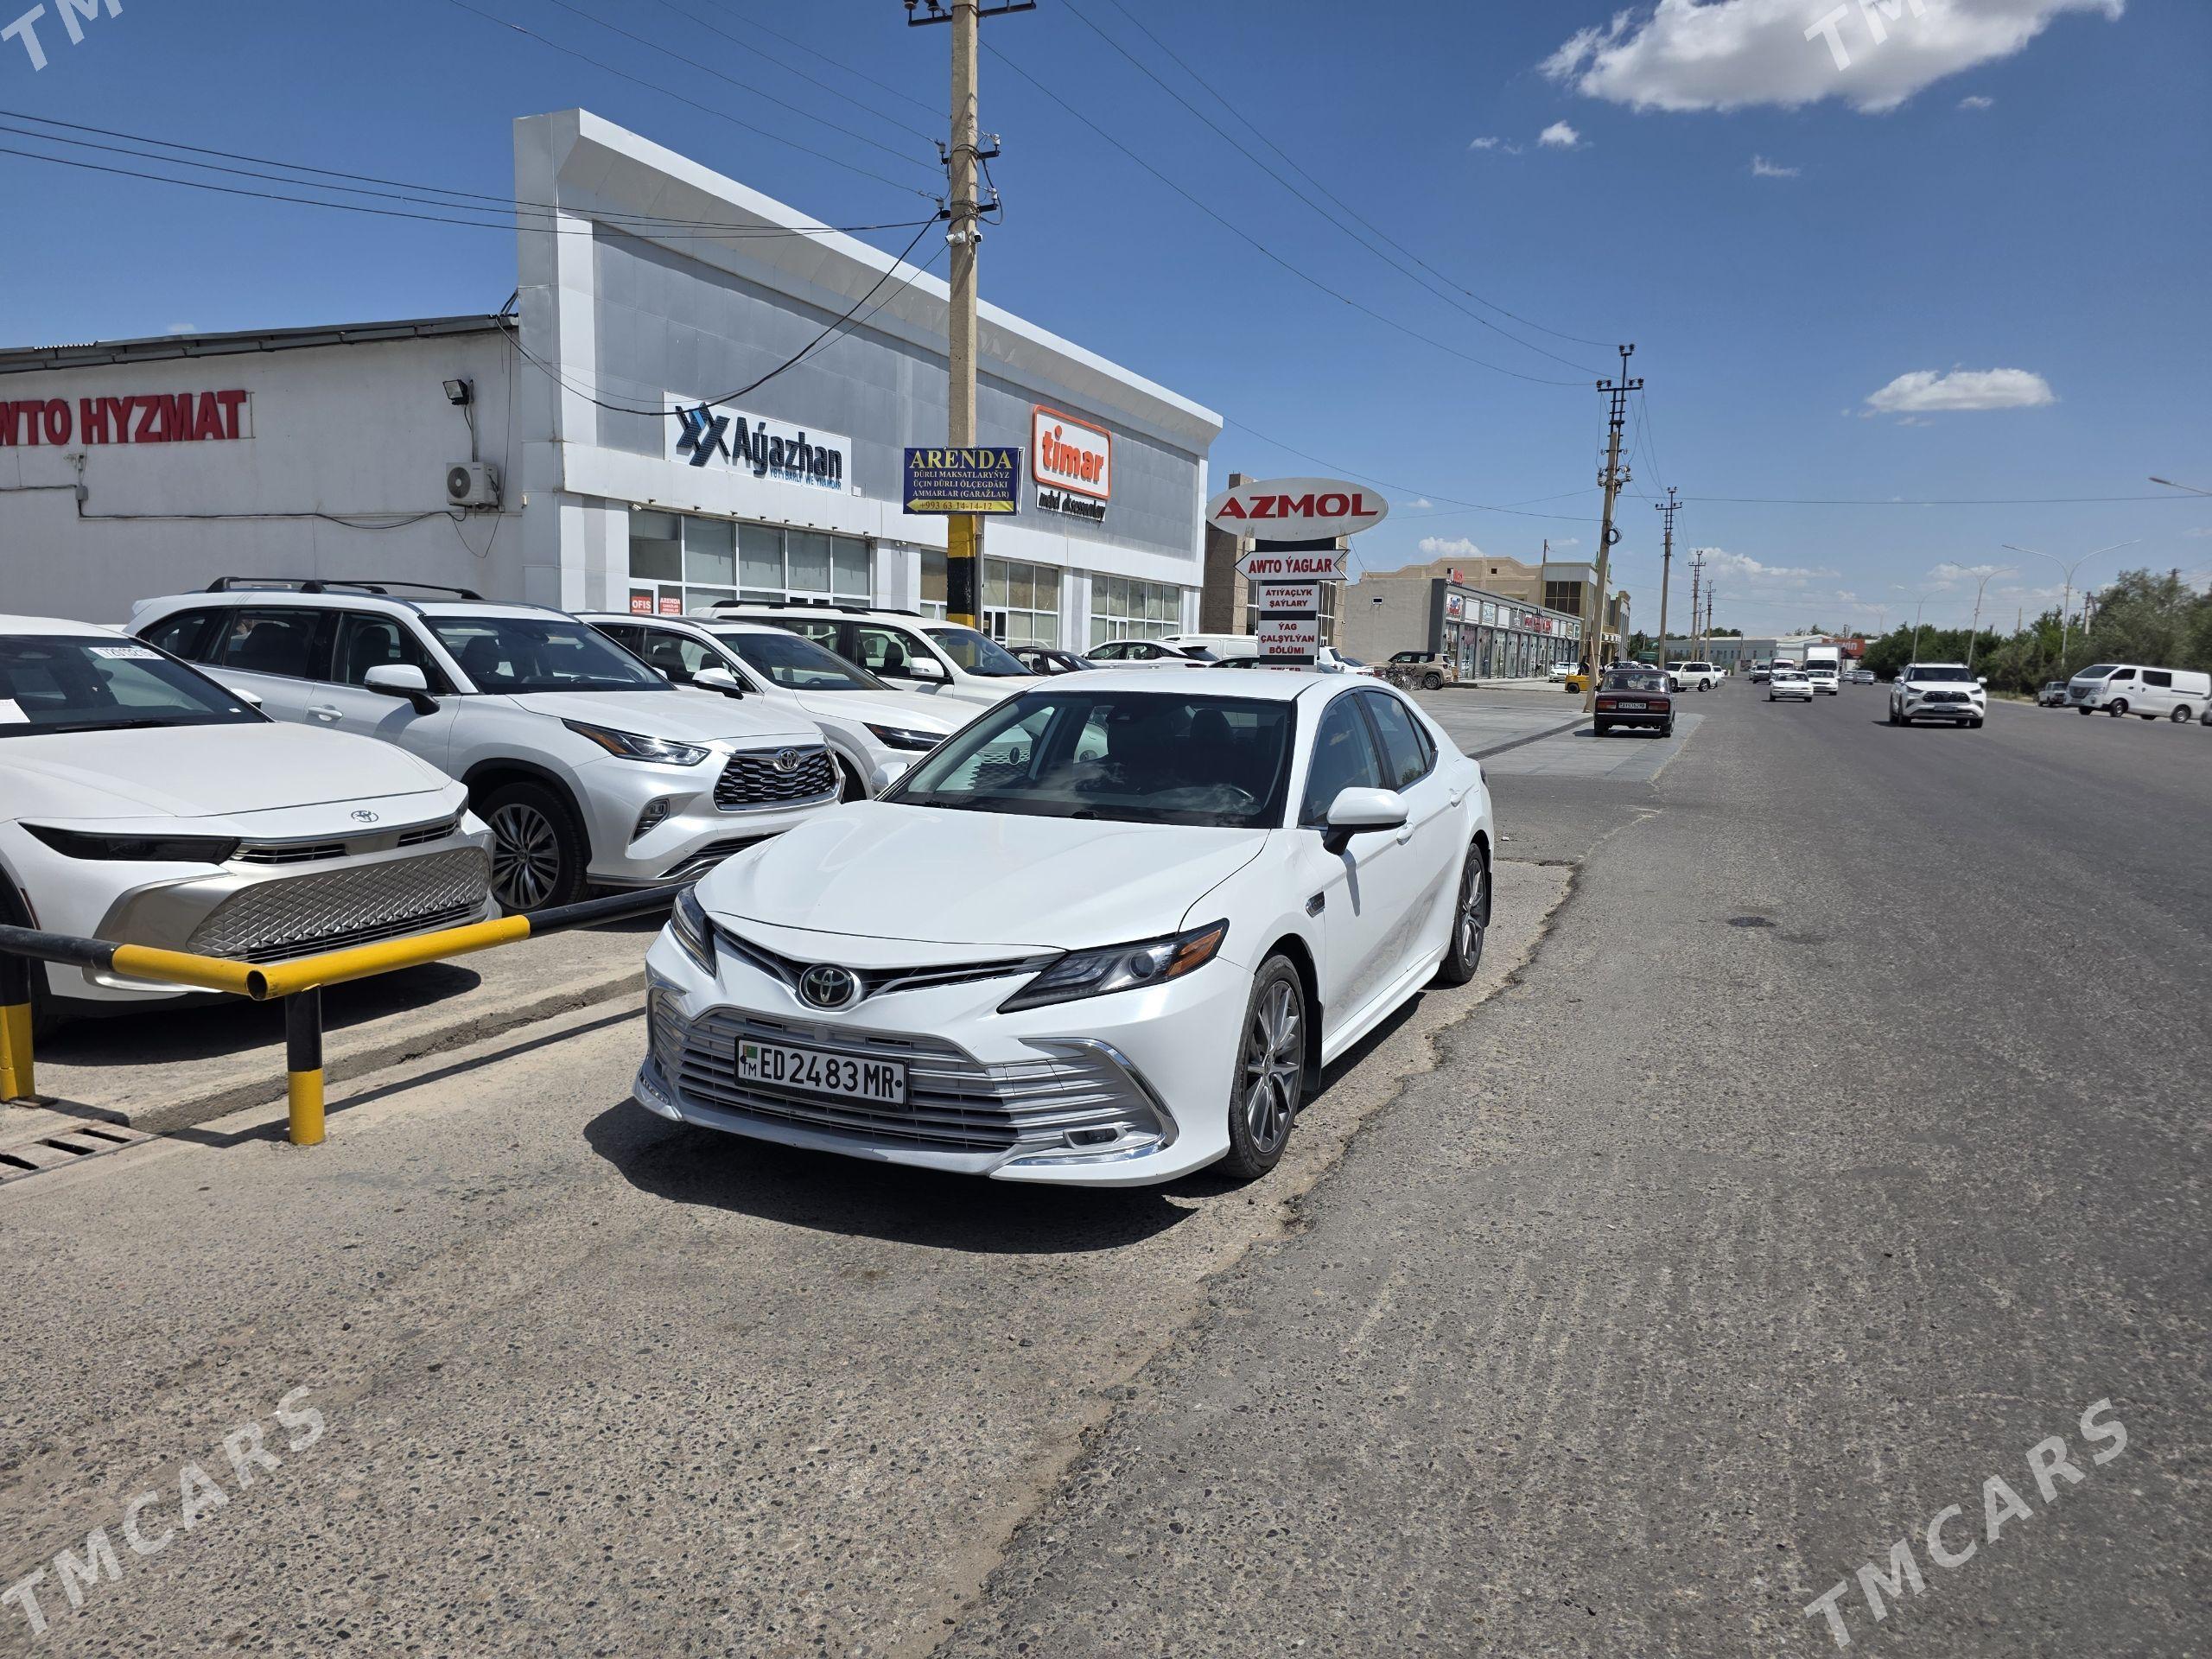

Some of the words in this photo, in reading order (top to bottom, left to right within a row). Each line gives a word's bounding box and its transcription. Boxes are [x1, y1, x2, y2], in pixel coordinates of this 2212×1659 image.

[79, 390, 246, 444] HYZMAT
[1042, 424, 1104, 483] timar
[909, 450, 1013, 468] ARENDA
[914, 469, 938, 478] DÜRLI
[960, 489, 1009, 499] (GARAŽLAR)
[919, 501, 940, 510] +993
[943, 501, 953, 510] 63
[957, 501, 993, 510] 14-14-12
[1215, 493, 1379, 519] AZMOL
[1248, 560, 1282, 574] AWTO
[1286, 556, 1332, 573] ÝAGLAR
[632, 600, 652, 609] OFIS
[1269, 599, 1308, 607] ŞAÝLARY
[1279, 621, 1297, 630] ÝAG
[1269, 645, 1305, 654] BÖLÜMI
